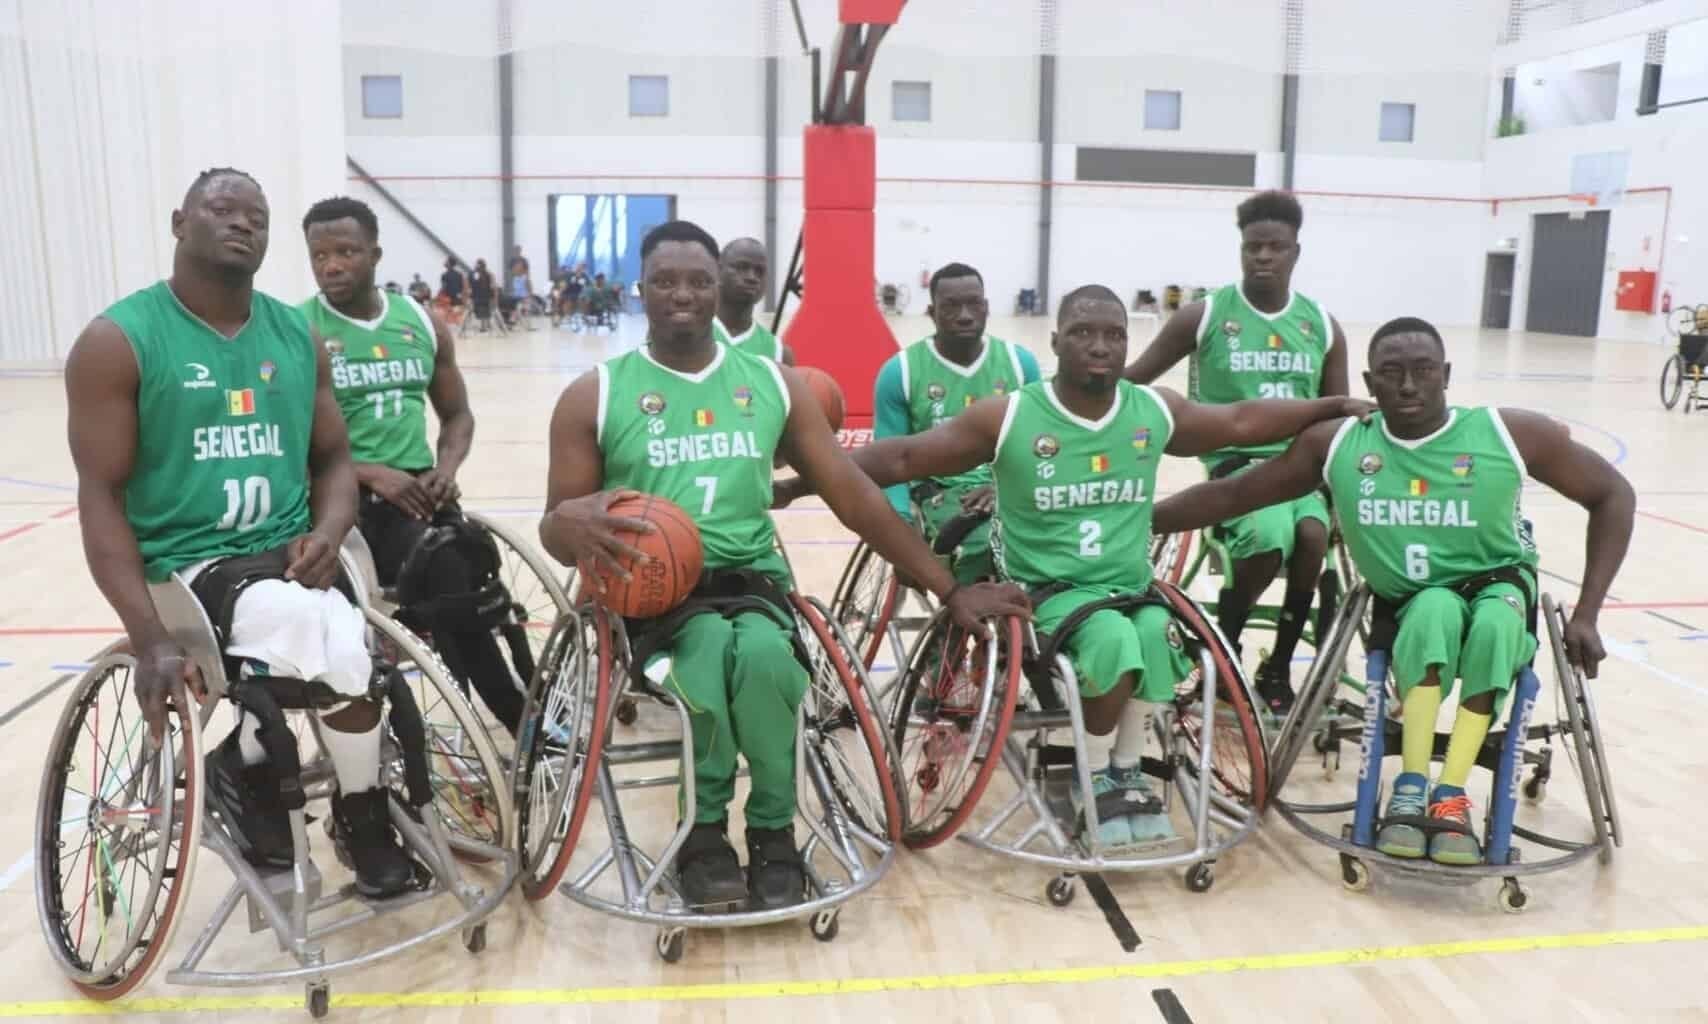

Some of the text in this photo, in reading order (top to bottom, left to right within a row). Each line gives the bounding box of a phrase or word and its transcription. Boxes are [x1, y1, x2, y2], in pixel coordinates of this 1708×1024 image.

[331, 358, 430, 389] SENEGAL
[1229, 351, 1315, 373] SENEGAL
[365, 388, 404, 420] 77
[193, 422, 284, 461] SENEGAL
[647, 430, 763, 468] SENEGAL
[215, 475, 272, 533] 10
[695, 475, 720, 515] 7
[1033, 477, 1147, 512] SENEGAL
[1357, 498, 1478, 528] SENEGAL
[1078, 519, 1103, 556] 2
[1404, 542, 1431, 581] 6
